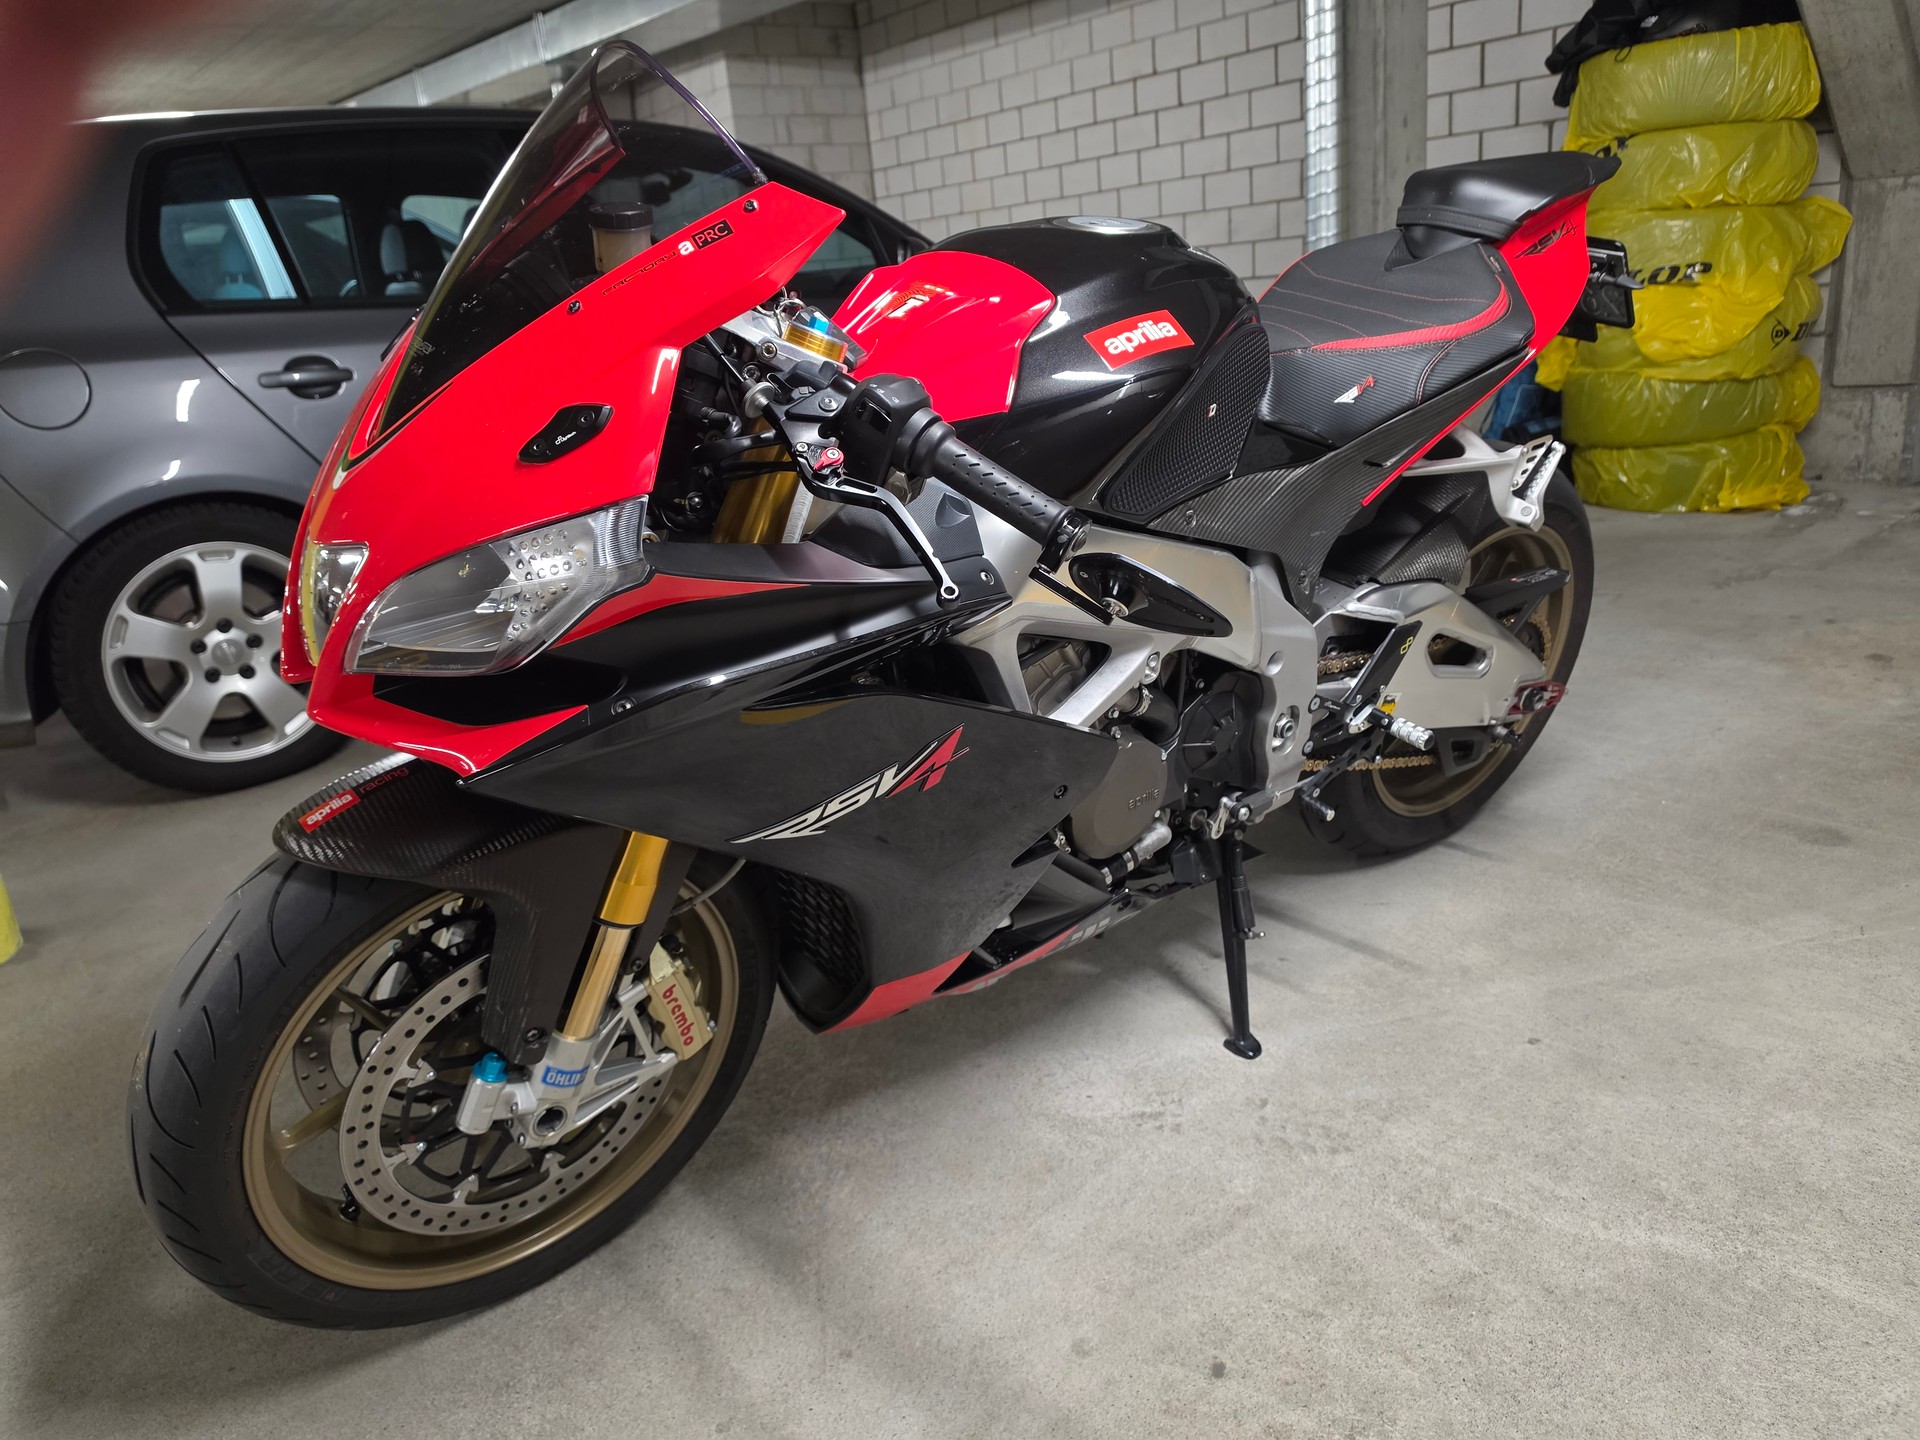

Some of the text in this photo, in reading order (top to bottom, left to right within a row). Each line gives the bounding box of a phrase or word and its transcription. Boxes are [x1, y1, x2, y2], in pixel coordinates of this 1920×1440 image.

[694, 223, 728, 246] PRC
[1104, 319, 1179, 354] aprilia
[306, 766, 410, 825] aprilia racing
[725, 722, 970, 844] RSV4
[661, 982, 695, 1047] brembo
